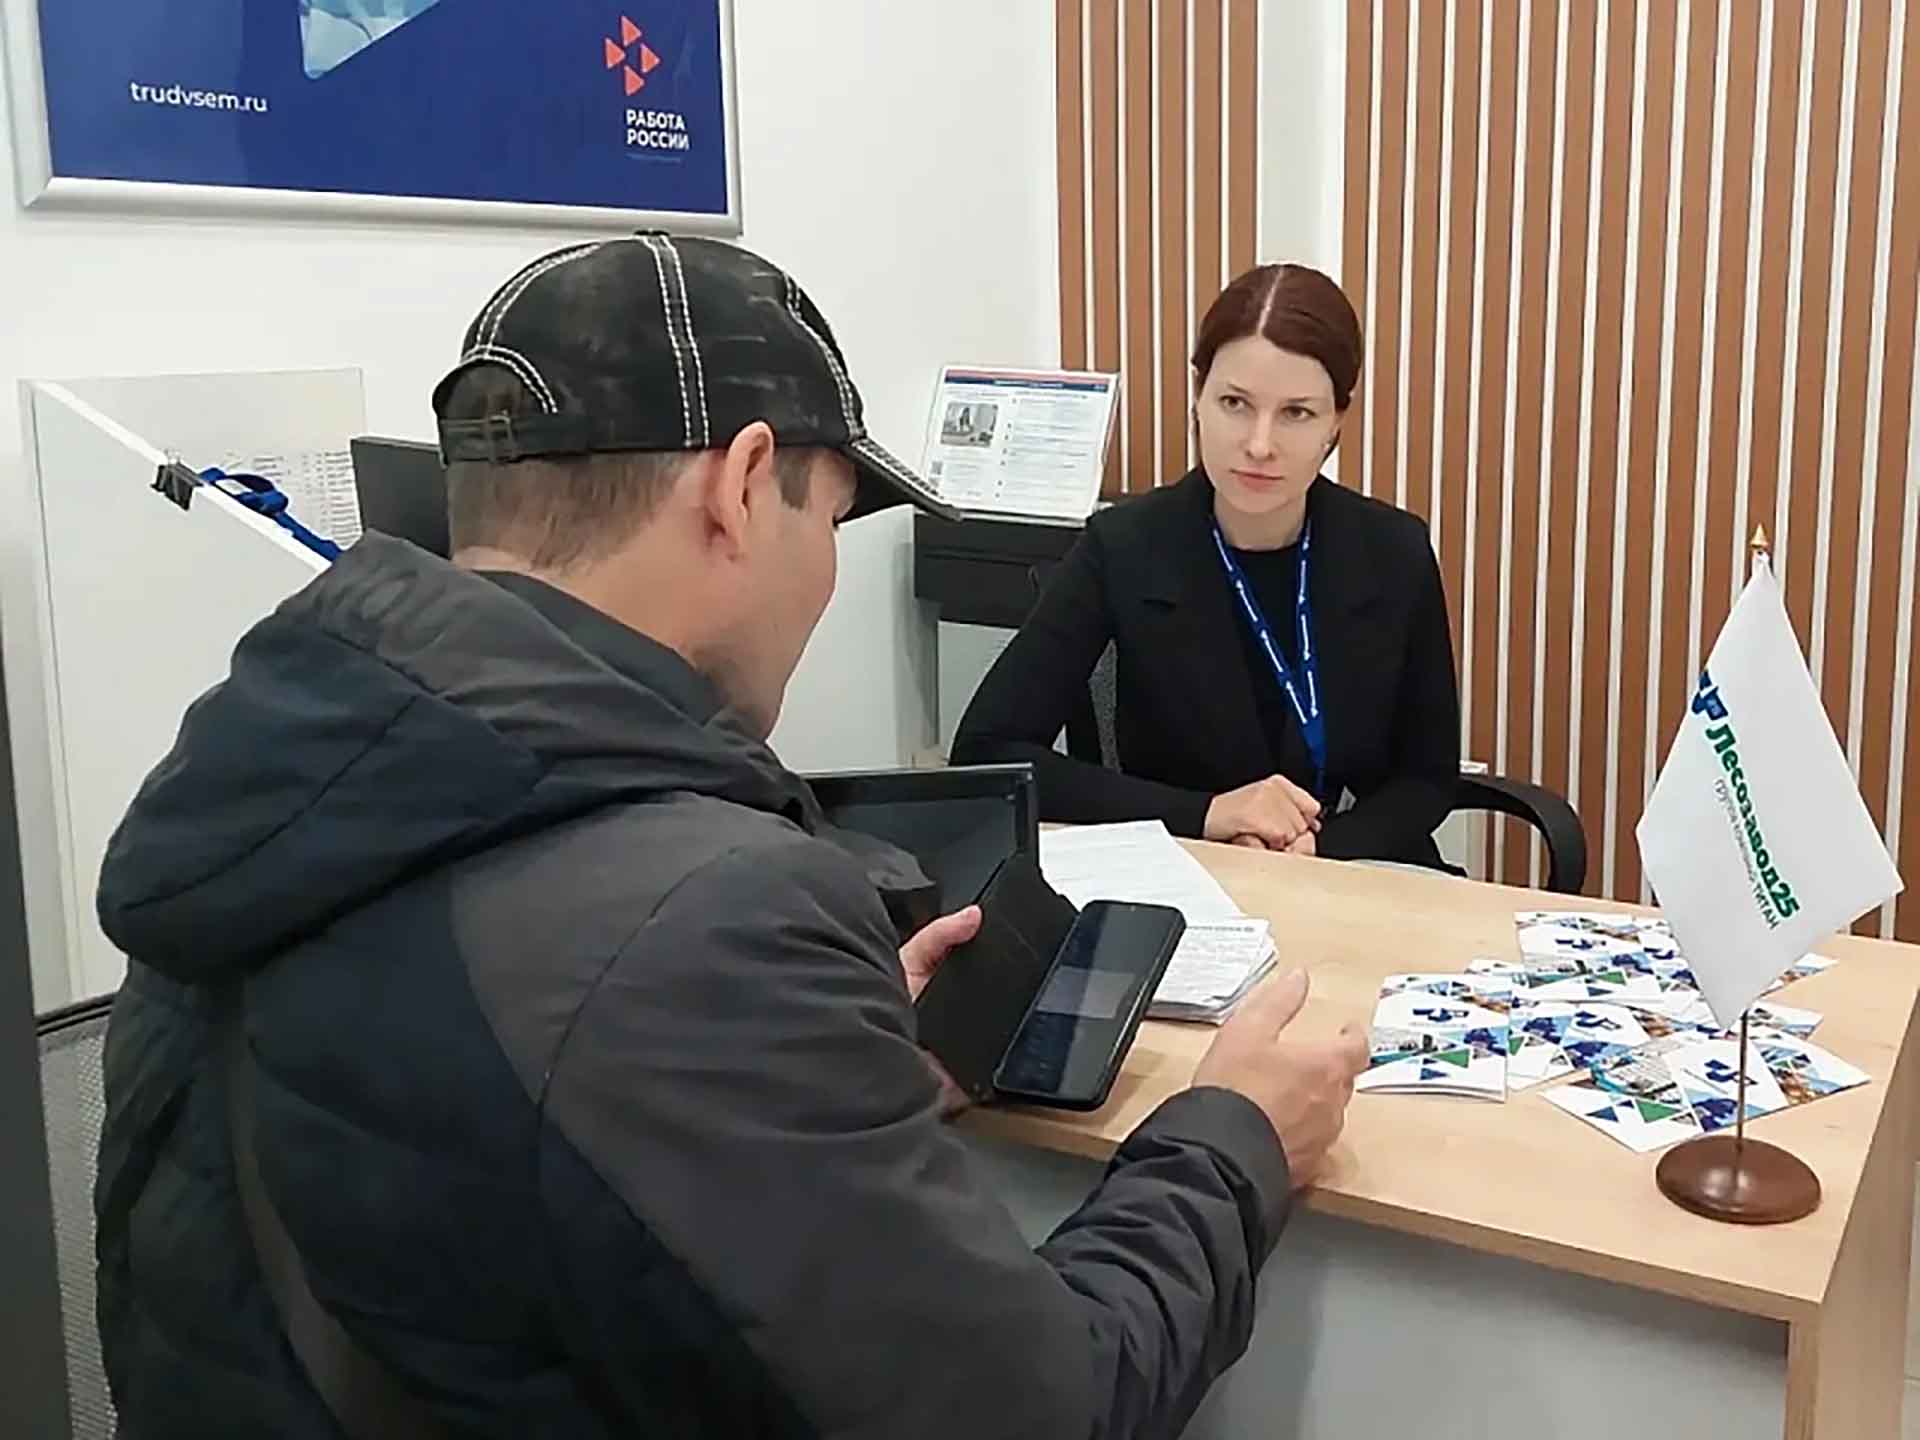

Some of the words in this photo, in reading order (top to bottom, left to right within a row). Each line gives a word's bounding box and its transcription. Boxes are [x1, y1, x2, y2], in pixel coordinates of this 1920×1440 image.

[130, 82, 268, 112] trudvsem.ru
[626, 108, 686, 131] РАБОТА
[626, 128, 690, 150] РОССИИ
[1705, 723, 1800, 918] Лесозавод25
